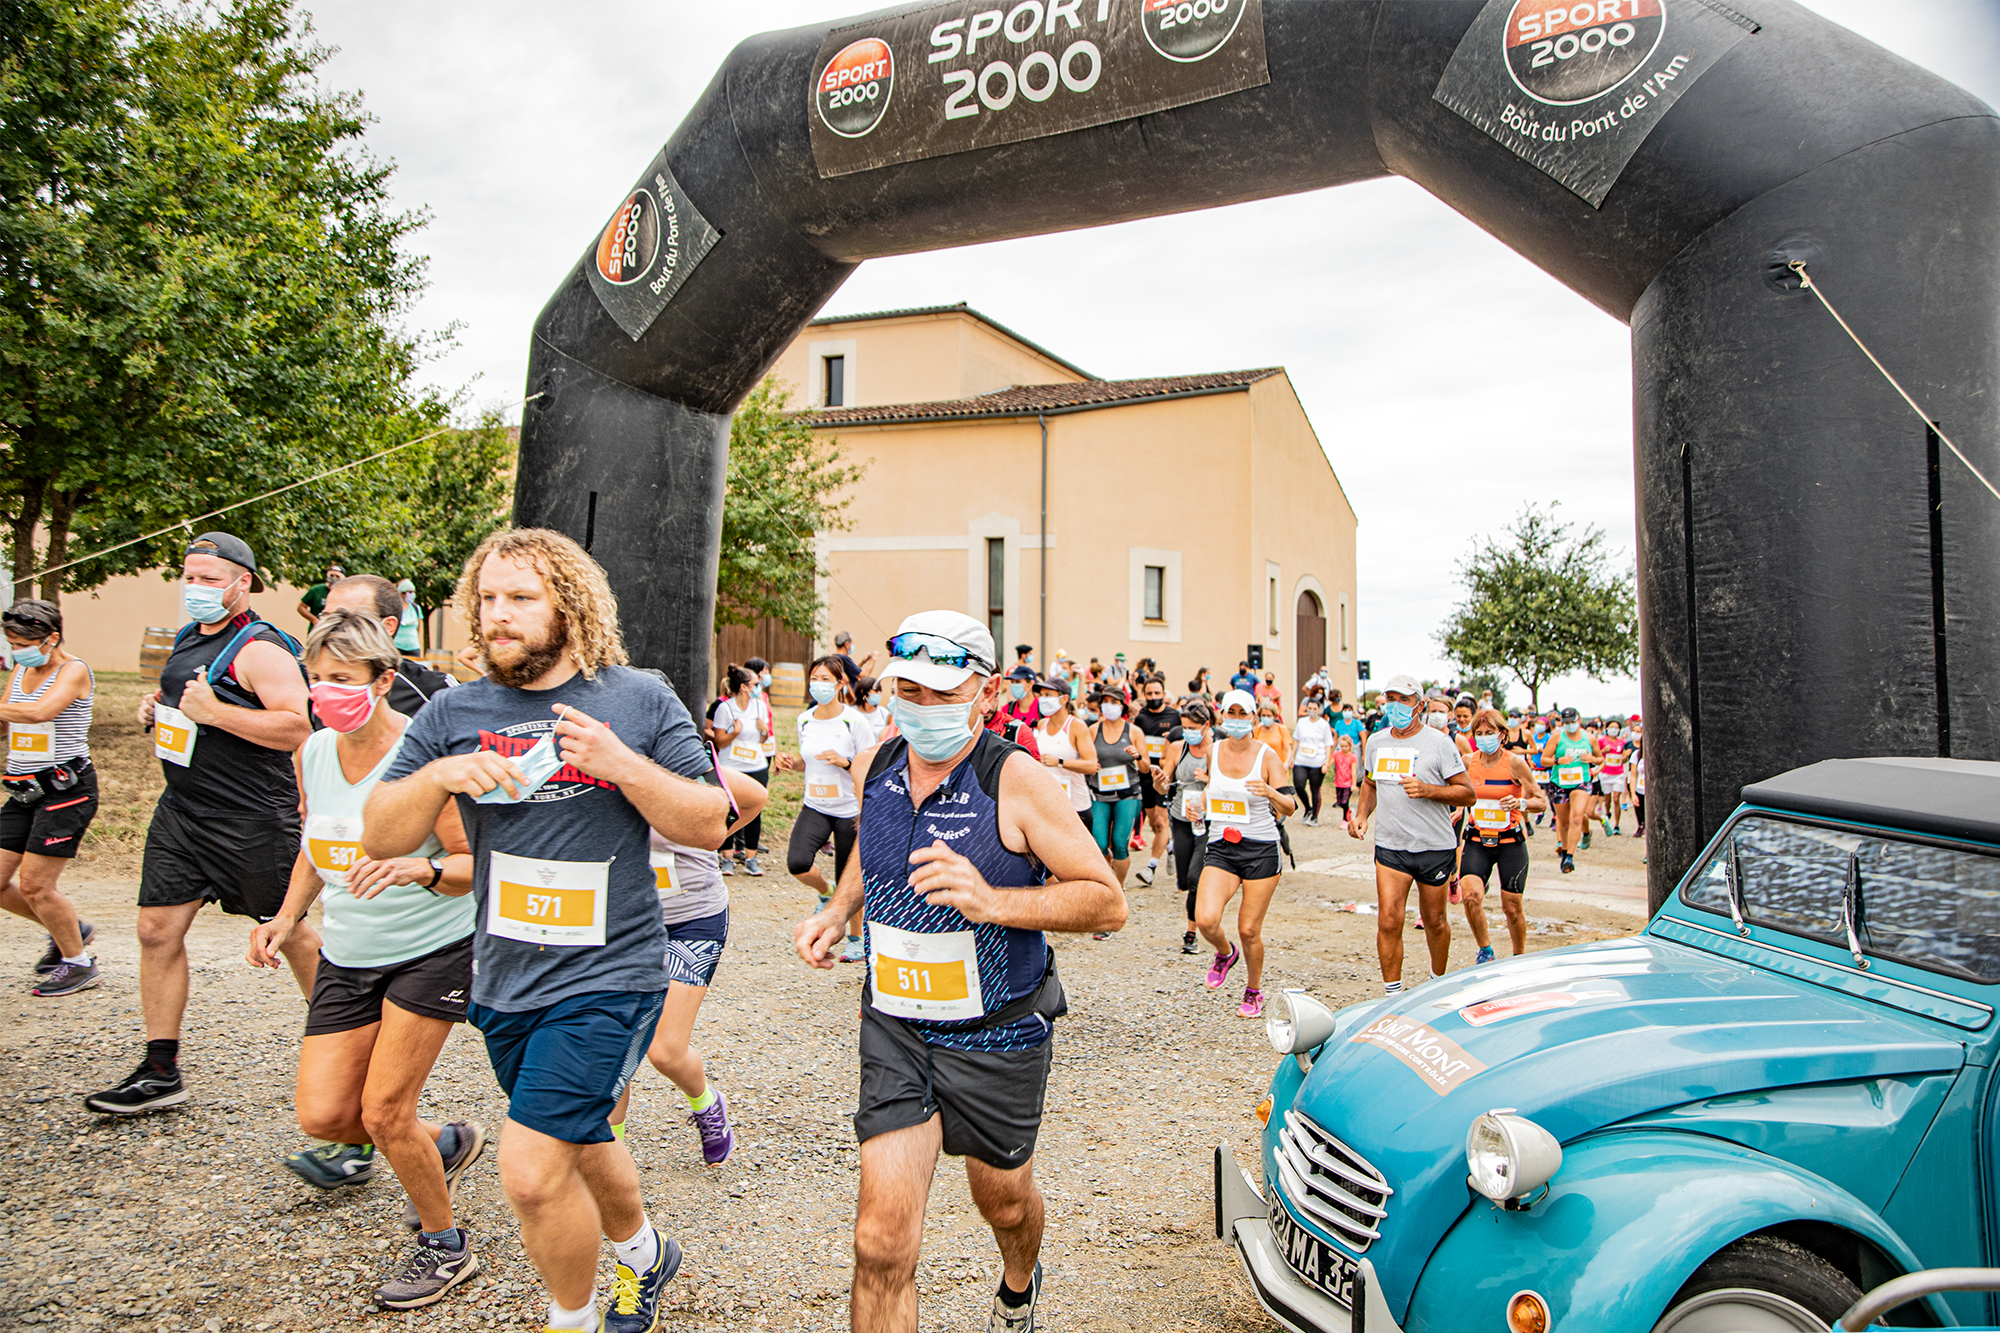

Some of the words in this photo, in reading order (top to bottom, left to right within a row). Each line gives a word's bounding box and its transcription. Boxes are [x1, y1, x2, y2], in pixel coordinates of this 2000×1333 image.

[1160, 0, 1229, 30] 2000
[1518, 0, 1641, 41] SPORT
[1531, 22, 1635, 68] 2000
[825, 59, 887, 89] SPORT
[943, 40, 1101, 120] 2000
[830, 81, 879, 109] 2000
[1499, 103, 1540, 140] Bout
[1542, 121, 1566, 142] du
[1571, 110, 1618, 141] Pont
[1620, 92, 1648, 120] de
[664, 195, 675, 213] de
[609, 202, 632, 275] SPORT
[623, 204, 642, 267] 2000
[667, 213, 679, 246] Pont
[665, 251, 678, 268] du
[650, 268, 673, 295] Bout
[1386, 760, 1400, 771] 591
[1221, 802, 1235, 812] 592
[1483, 811, 1496, 820] 506
[329, 846, 357, 866] 587
[527, 894, 562, 918] 571
[897, 966, 931, 992] 511
